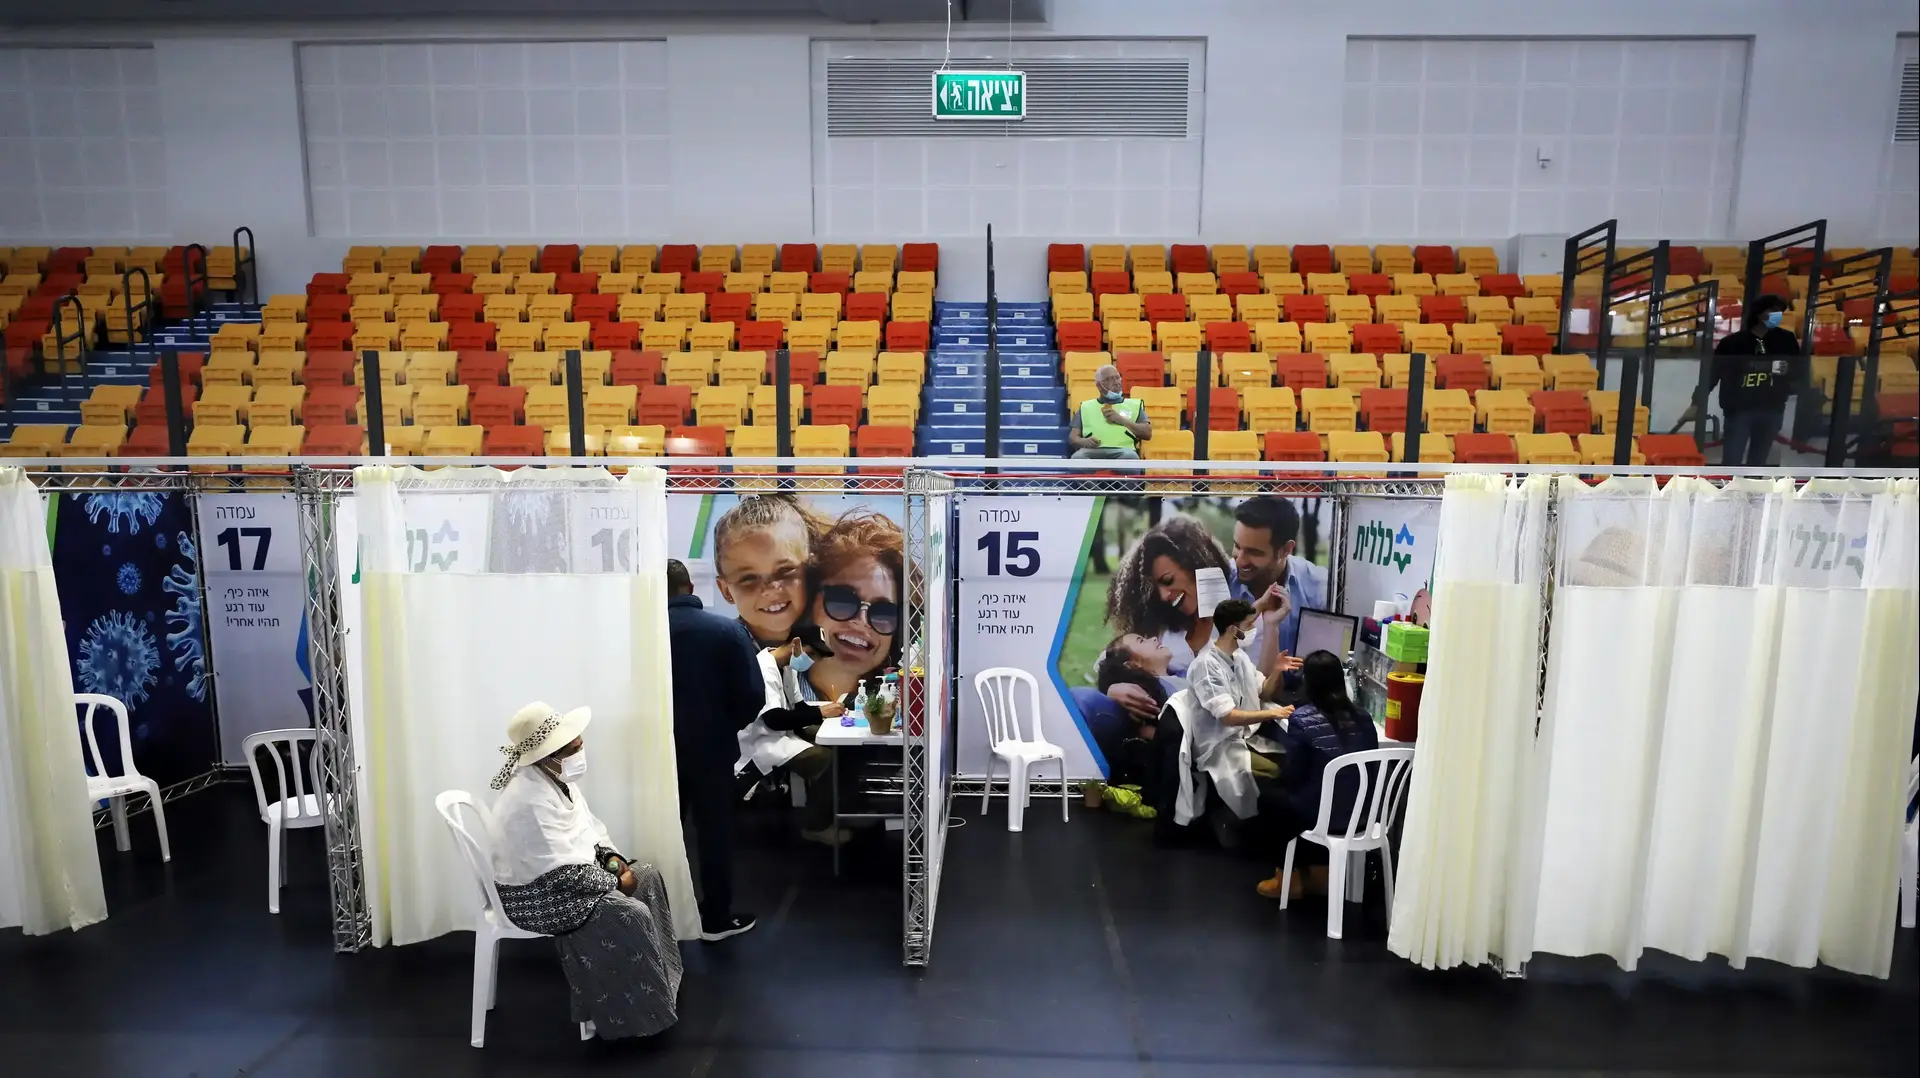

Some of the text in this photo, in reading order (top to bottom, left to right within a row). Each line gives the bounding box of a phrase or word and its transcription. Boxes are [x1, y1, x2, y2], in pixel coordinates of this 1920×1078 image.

[967, 80, 1019, 111] יציאה
[216, 506, 256, 519] עמדה
[979, 509, 1020, 522] עמדה
[217, 527, 272, 571] 17
[1353, 520, 1393, 566] כללית
[977, 531, 1041, 578] 15
[224, 588, 269, 600] איזה כיף,
[978, 594, 1026, 606] איזה כיף,
[225, 603, 265, 613] עוד רגע
[977, 609, 1020, 619] עוד רגע
[226, 616, 280, 627] תהיו אחרי!
[977, 623, 1034, 634] תהיו אחרי!
